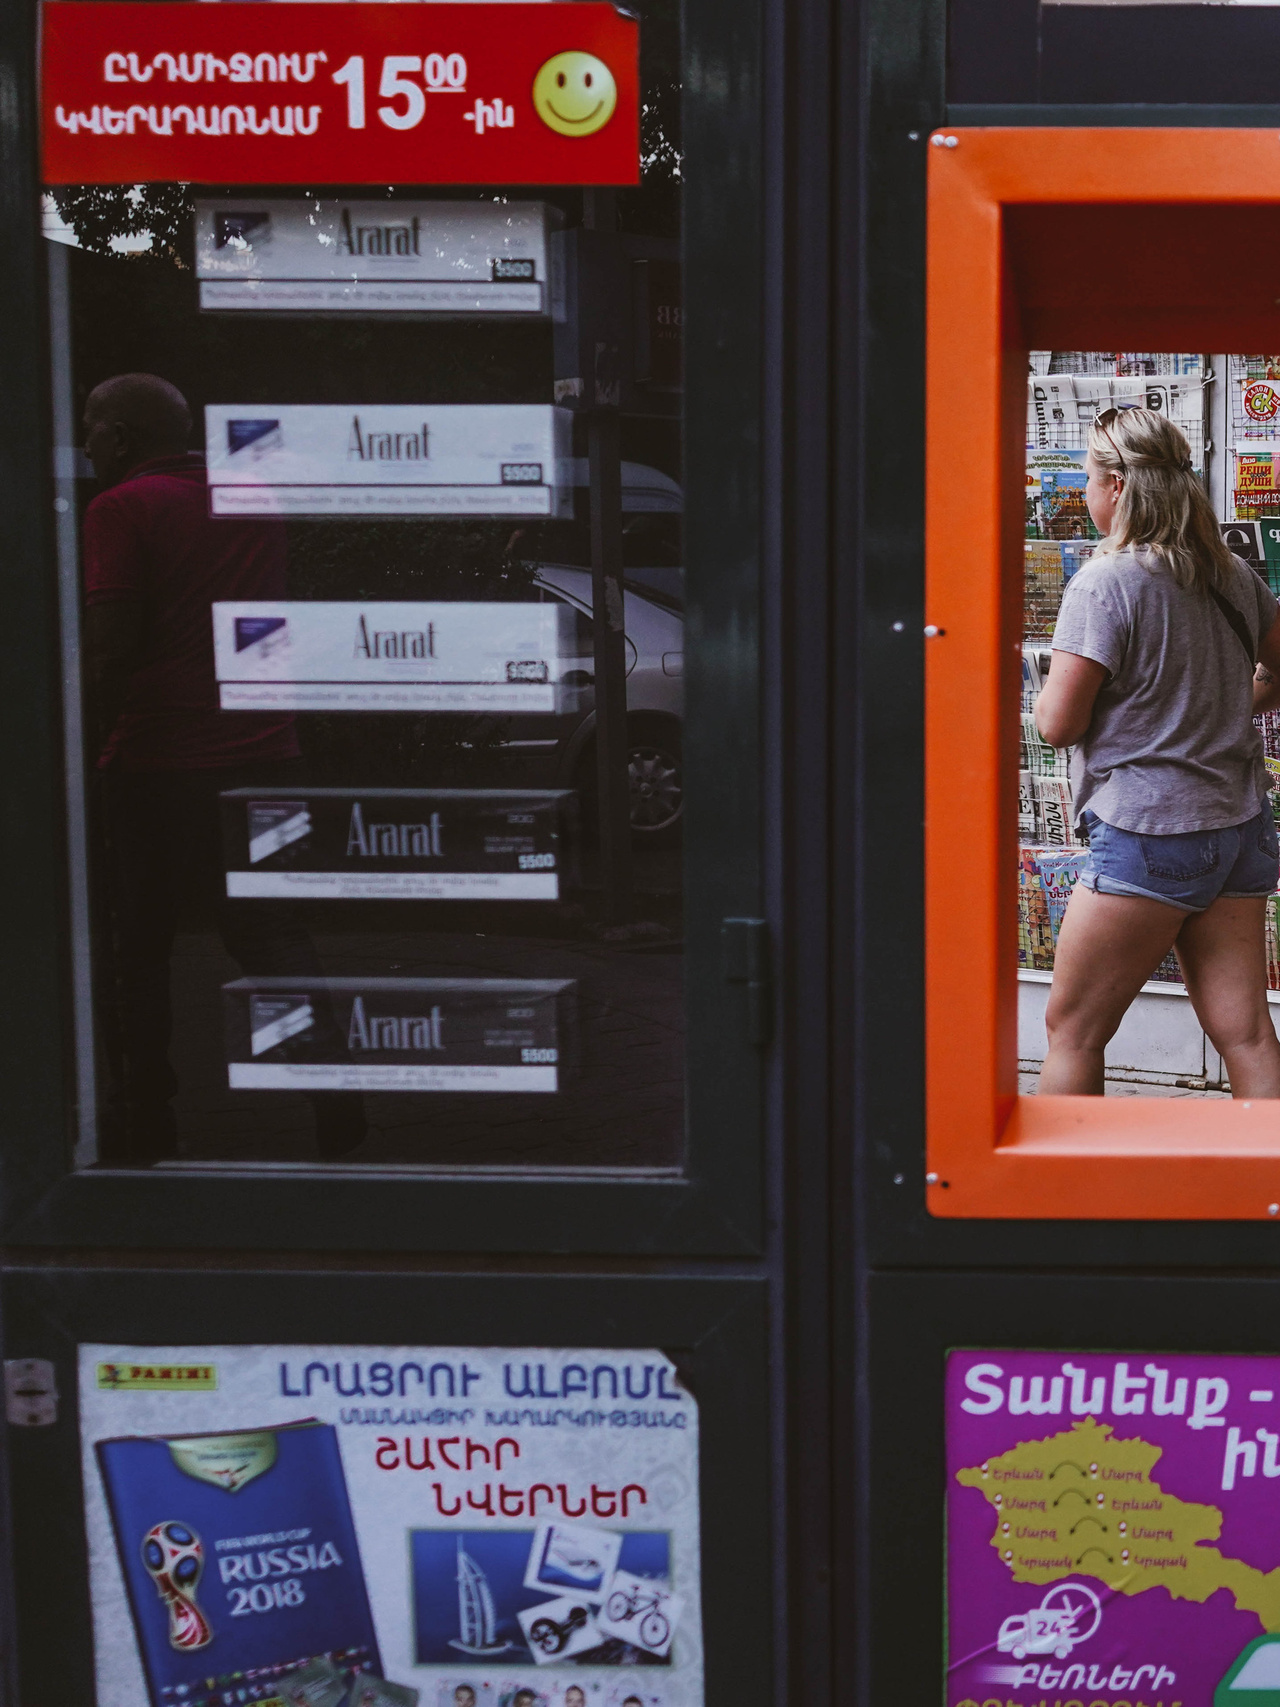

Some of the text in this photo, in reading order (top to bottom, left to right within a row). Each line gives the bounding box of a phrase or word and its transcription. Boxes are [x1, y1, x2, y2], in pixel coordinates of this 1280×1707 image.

[55, 104, 321, 136] ԿՎԵՐԱԴԱՌՆԱՄ
[337, 206, 423, 257] Ararat
[347, 414, 433, 460] Ararat
[1240, 465, 1272, 475] РЕШИ
[1240, 477, 1272, 488] ДУШИ
[353, 613, 440, 660] Ararat
[347, 802, 447, 857] Ararat
[347, 995, 447, 1050] Ararat
[131, 1365, 210, 1379] PANINI
[280, 1361, 482, 1398] ԼՐԱՑՐՈՒ
[960, 1362, 1230, 1430] Տանենք
[375, 1436, 521, 1471] ՇԱՀԻՐ
[431, 1482, 648, 1518] ՆՎԵՐՆԵՐ
[218, 1541, 343, 1584] RUSSIA
[226, 1578, 306, 1617] 2018
[1013, 1662, 1176, 1690] ԲԵՌՆԵՐԻ
